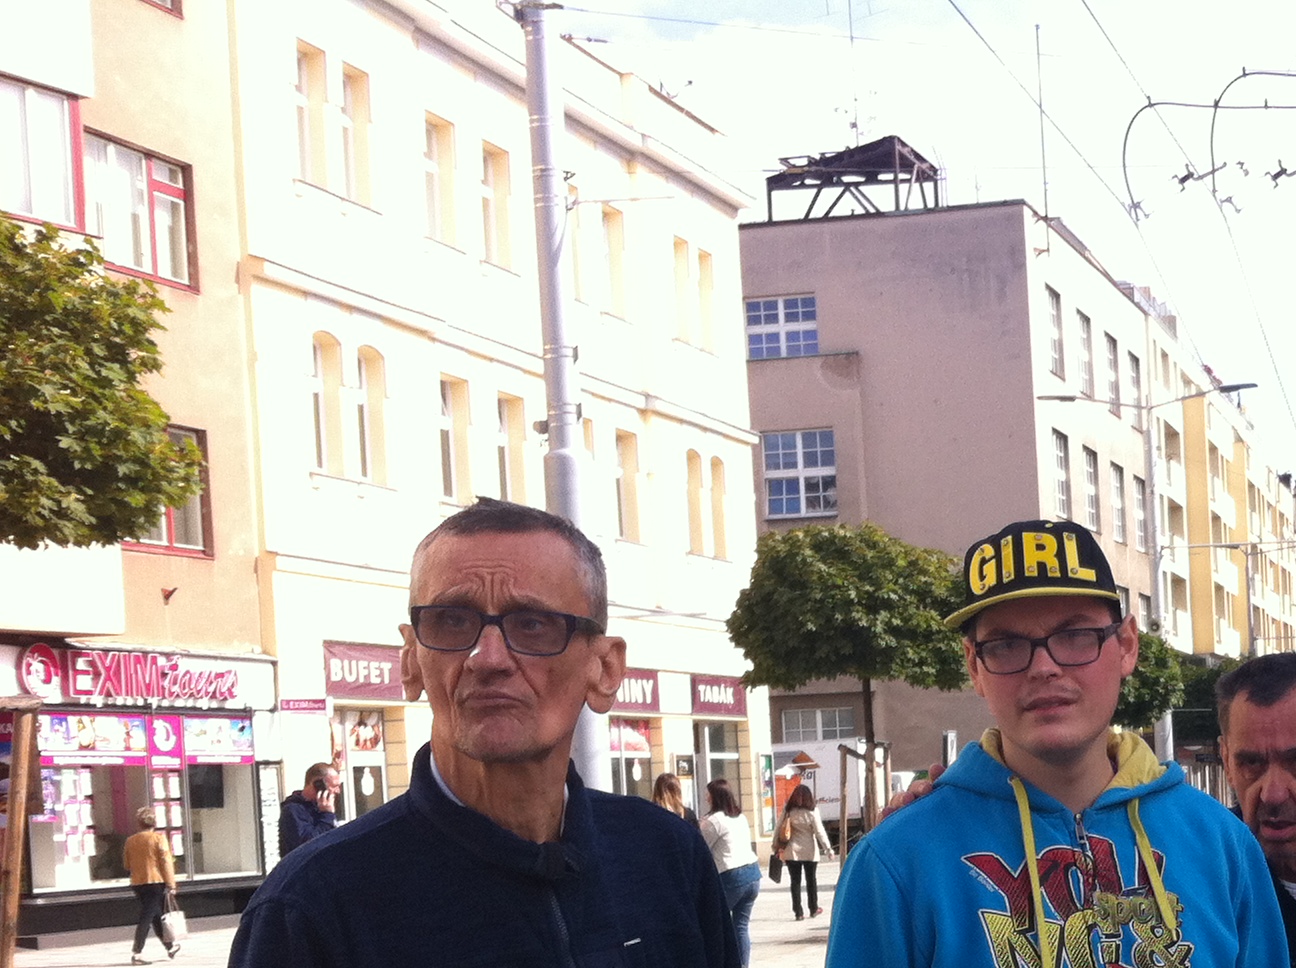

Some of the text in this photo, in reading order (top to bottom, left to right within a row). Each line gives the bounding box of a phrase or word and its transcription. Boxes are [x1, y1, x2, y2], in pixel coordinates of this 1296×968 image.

[969, 531, 1097, 595] GIRL
[70, 650, 162, 699] EXIM
[329, 658, 392, 684] BUFET
[698, 683, 735, 704] TABÁK
